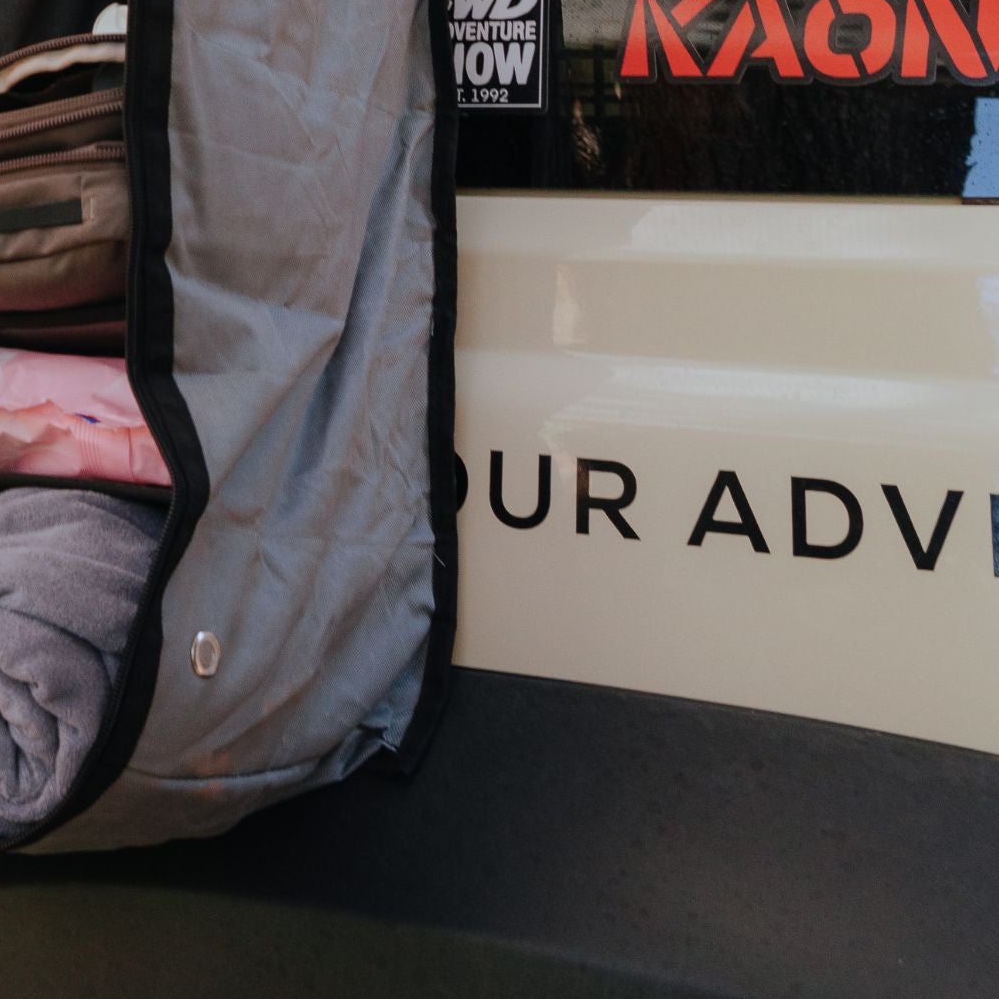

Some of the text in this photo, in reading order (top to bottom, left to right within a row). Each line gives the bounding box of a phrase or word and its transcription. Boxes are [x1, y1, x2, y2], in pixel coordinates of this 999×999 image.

[471, 87, 509, 102] 1992
[454, 449, 999, 578] UR ADV
